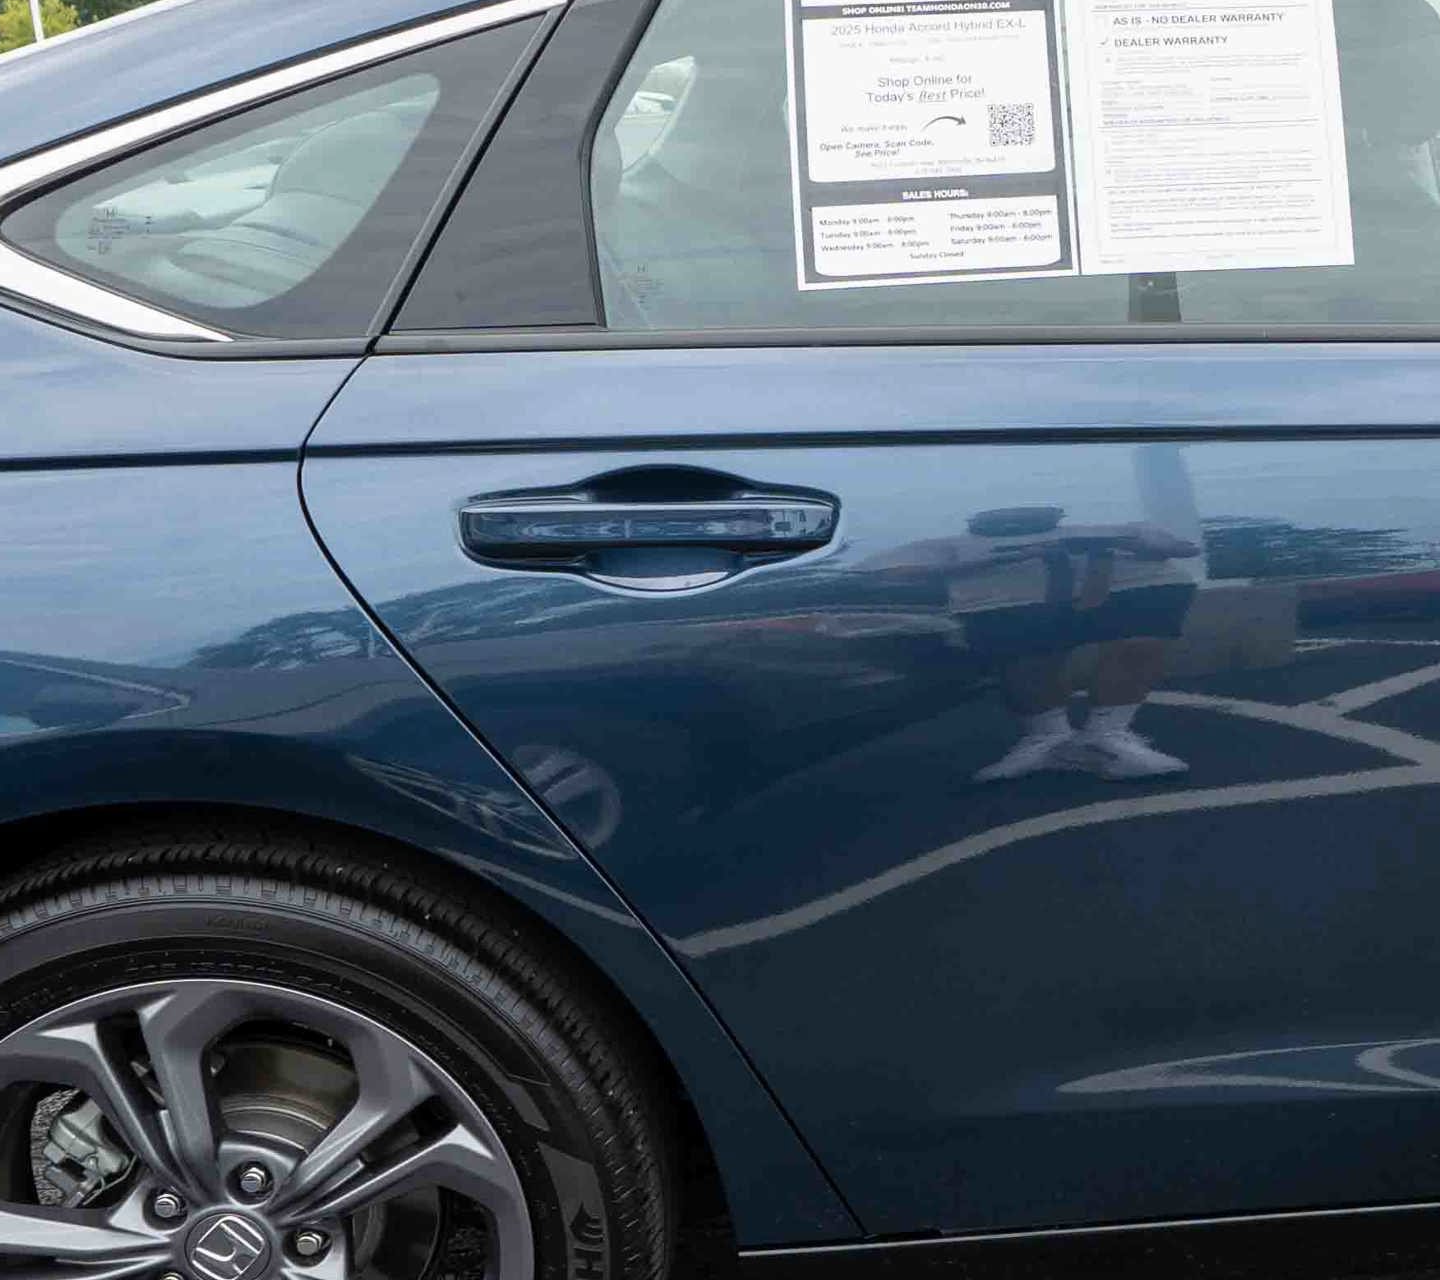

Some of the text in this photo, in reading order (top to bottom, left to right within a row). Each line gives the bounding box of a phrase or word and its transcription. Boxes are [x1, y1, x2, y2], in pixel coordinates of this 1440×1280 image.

[842, 6, 867, 16] SHOP
[1113, 16, 1129, 26] AS
[1131, 16, 1142, 25] IS
[1151, 15, 1169, 25] NO
[1171, 14, 1217, 24] DEALER
[1219, 12, 1284, 23] WARRANTY
[831, 18, 1027, 36] 2025 Honda Accord Hybrid EX-L
[1114, 35, 1228, 48] DEALER WARRANTY
[878, 74, 972, 91] Shop Online for
[865, 88, 985, 106] Today's Best Price!
[819, 142, 843, 152] Open
[884, 139, 907, 148] Scan
[902, 190, 932, 200] SALES
